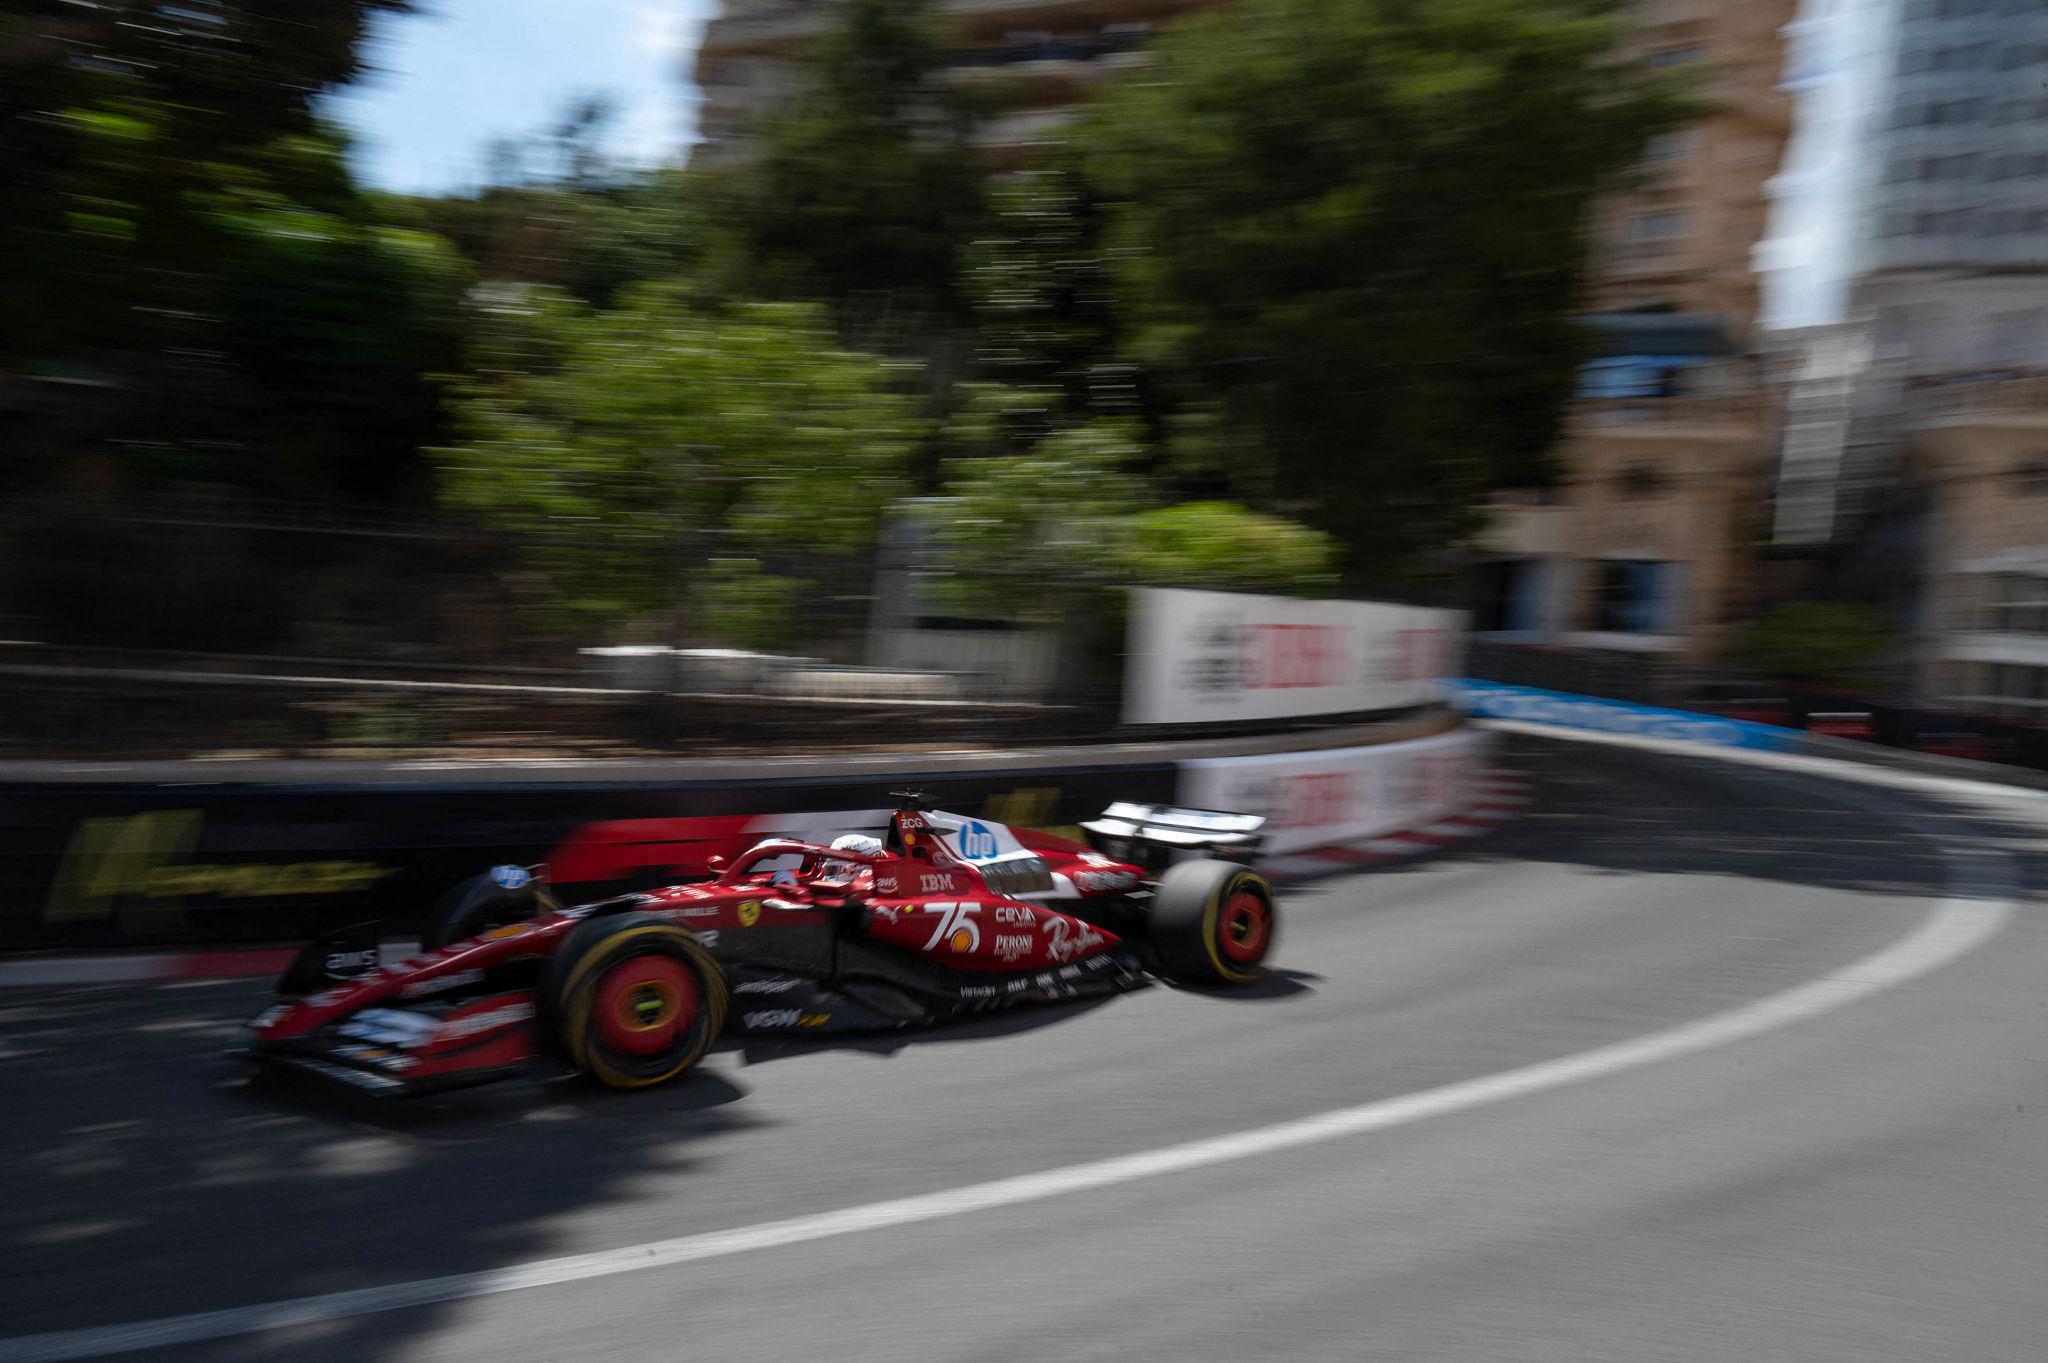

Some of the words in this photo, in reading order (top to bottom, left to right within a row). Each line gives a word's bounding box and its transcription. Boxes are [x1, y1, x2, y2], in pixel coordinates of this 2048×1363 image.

[962, 821, 995, 859] hp
[920, 873, 955, 892] IBM
[995, 906, 1036, 922] CEVA
[921, 902, 981, 953] 75
[996, 934, 1032, 951] PERONI
